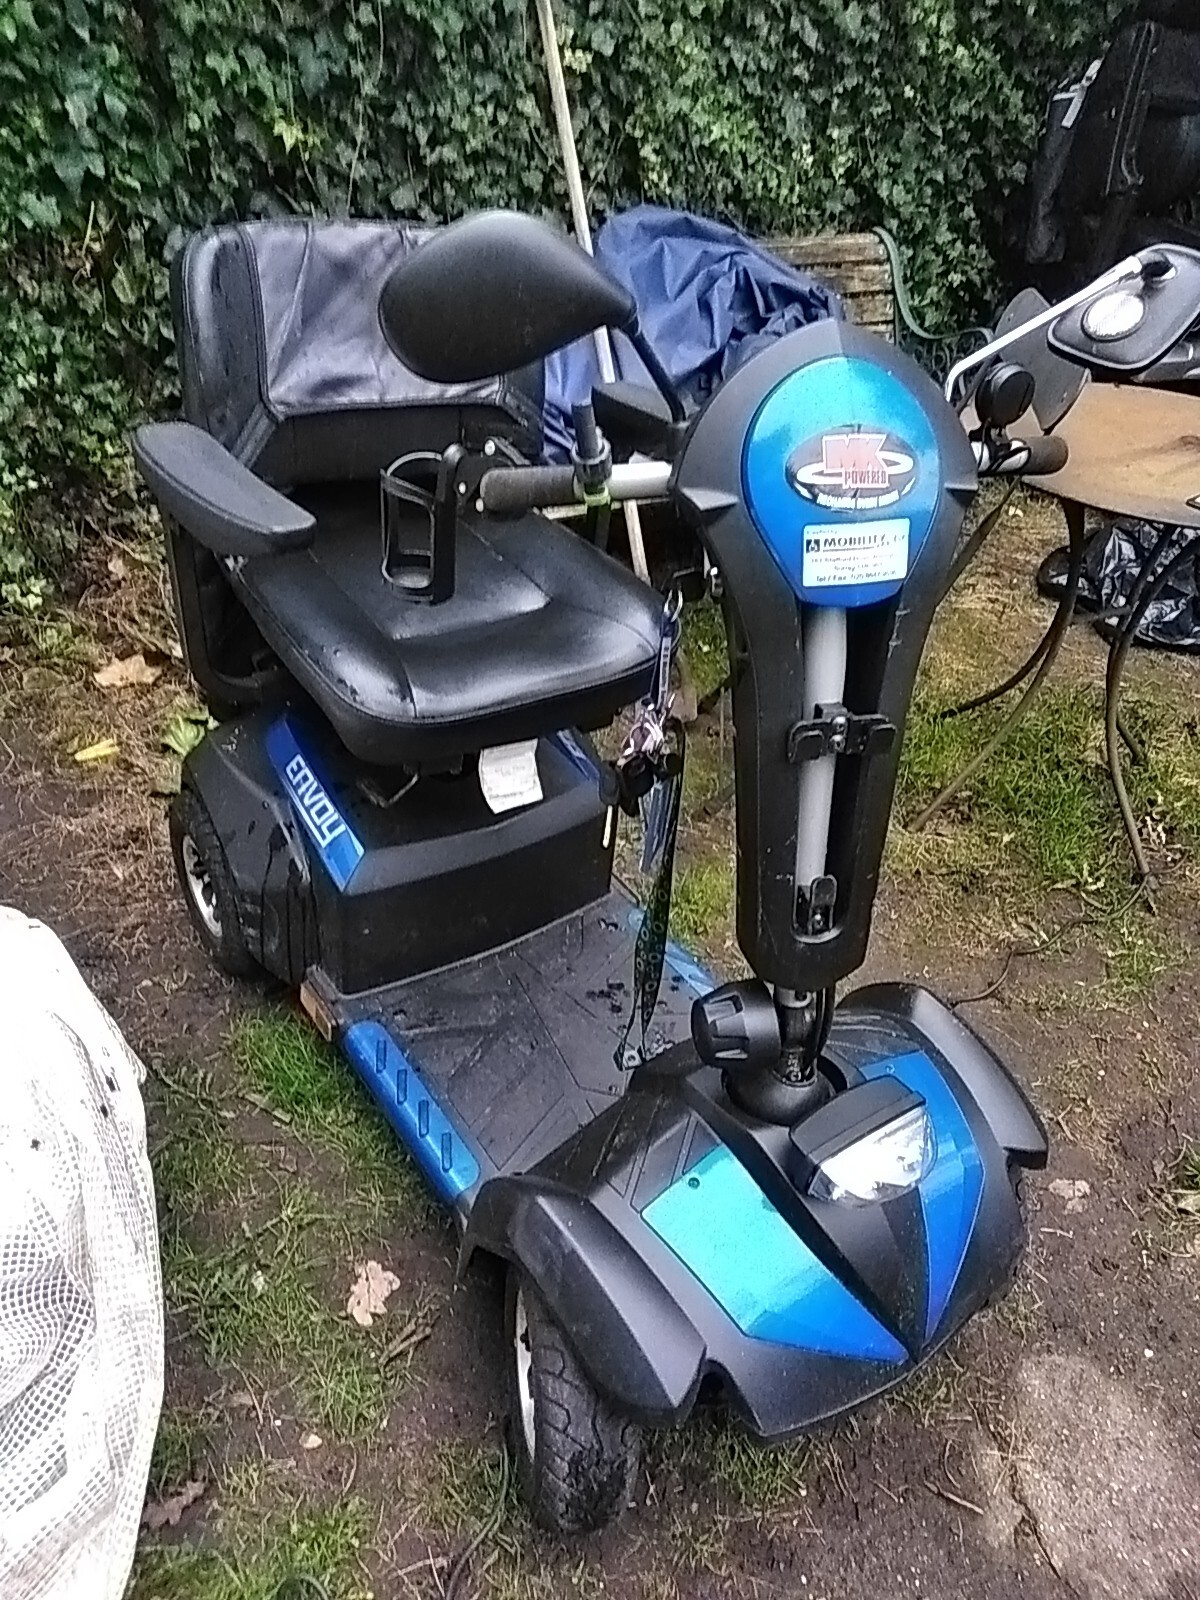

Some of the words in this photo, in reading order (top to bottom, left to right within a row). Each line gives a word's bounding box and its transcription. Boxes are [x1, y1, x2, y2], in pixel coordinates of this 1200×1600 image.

[822, 433, 887, 472] MK
[844, 469, 887, 485] POWERED
[285, 754, 346, 848] ENVOY
